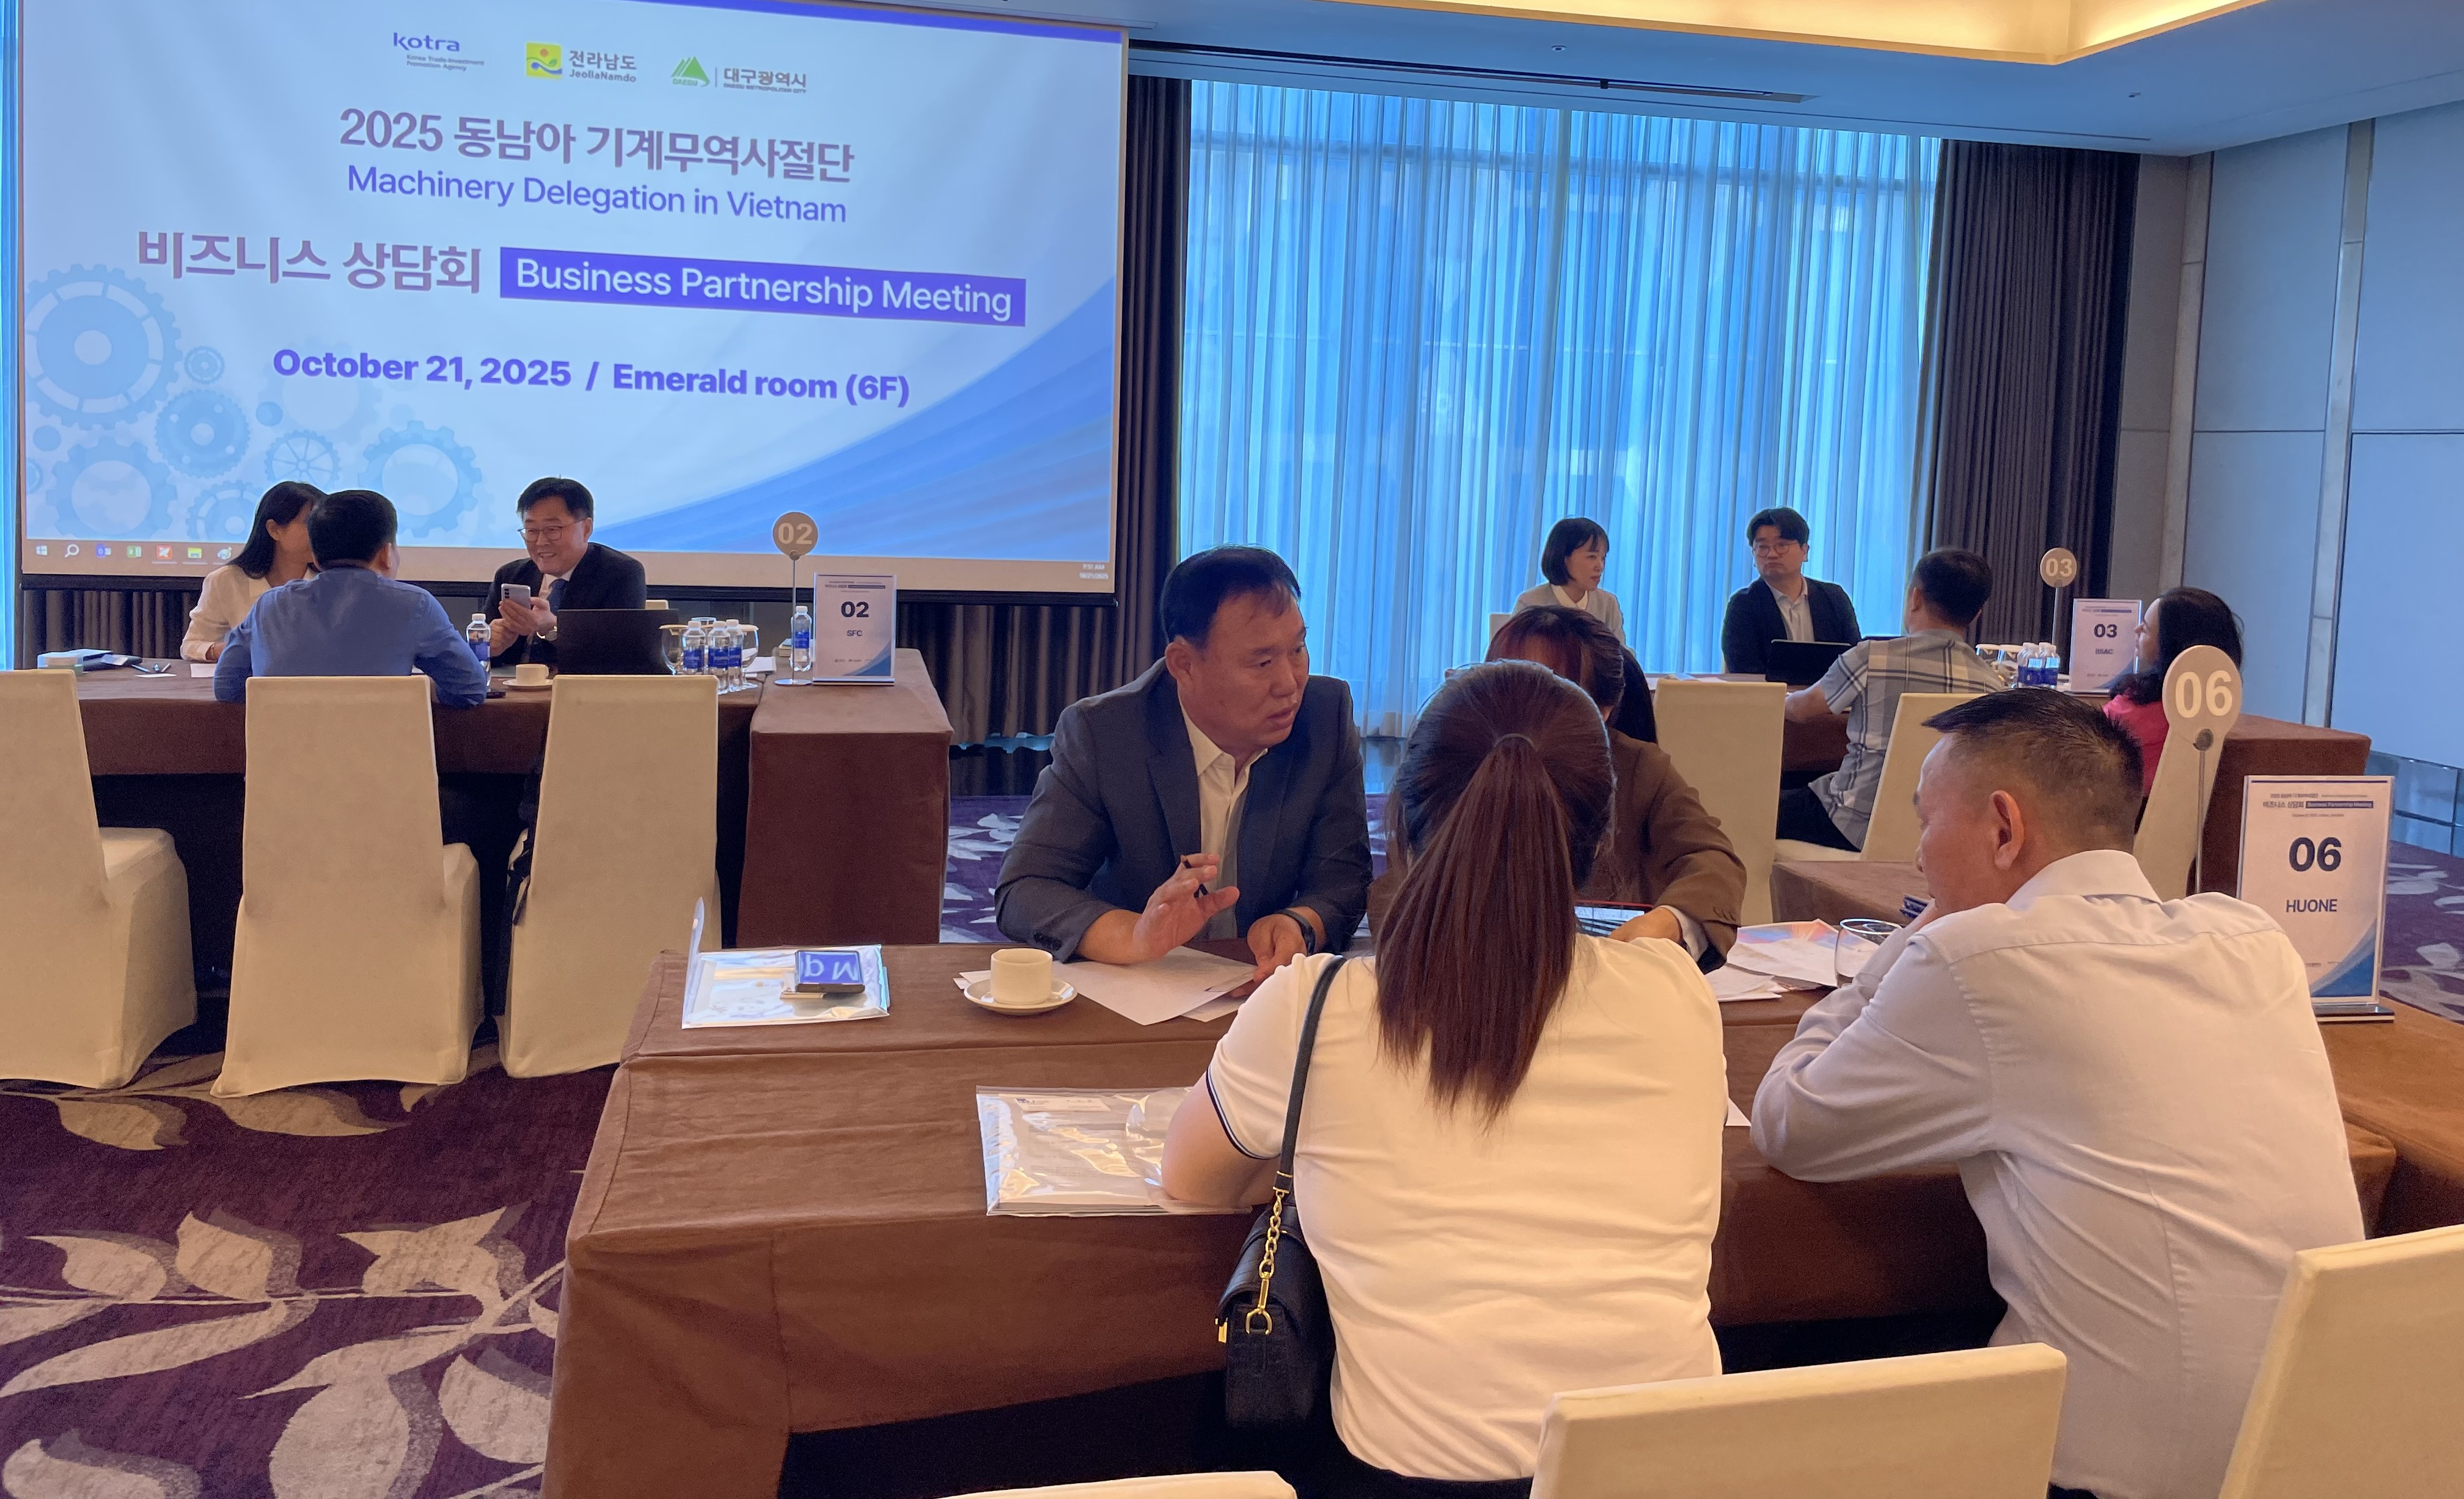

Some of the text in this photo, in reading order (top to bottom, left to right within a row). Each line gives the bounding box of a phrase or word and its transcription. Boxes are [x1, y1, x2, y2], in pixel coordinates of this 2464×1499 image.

[394, 32, 460, 51] kotra
[569, 50, 637, 71] 전라남도
[570, 69, 636, 82] JeollaNamdo
[724, 67, 806, 87] 대구광역시
[340, 108, 856, 183] 2025 동남아 기계무역사절단
[348, 164, 846, 222] Machinery Delegation in Vietnam
[138, 231, 482, 294] 비즈니스 상담회
[517, 258, 1011, 322] Business Partnership Meeting
[273, 349, 419, 381] October
[426, 355, 473, 390] 21,
[480, 357, 571, 386] 2025
[614, 364, 747, 395] Emerald
[755, 376, 837, 399] room
[846, 374, 909, 408] (6F)
[778, 522, 812, 545] 02
[2045, 557, 2073, 577] 03
[841, 601, 869, 618] 02
[2094, 623, 2118, 638] 03
[2175, 670, 2233, 719] 06
[2289, 837, 2342, 872] 06
[2286, 899, 2338, 913] HUONE
